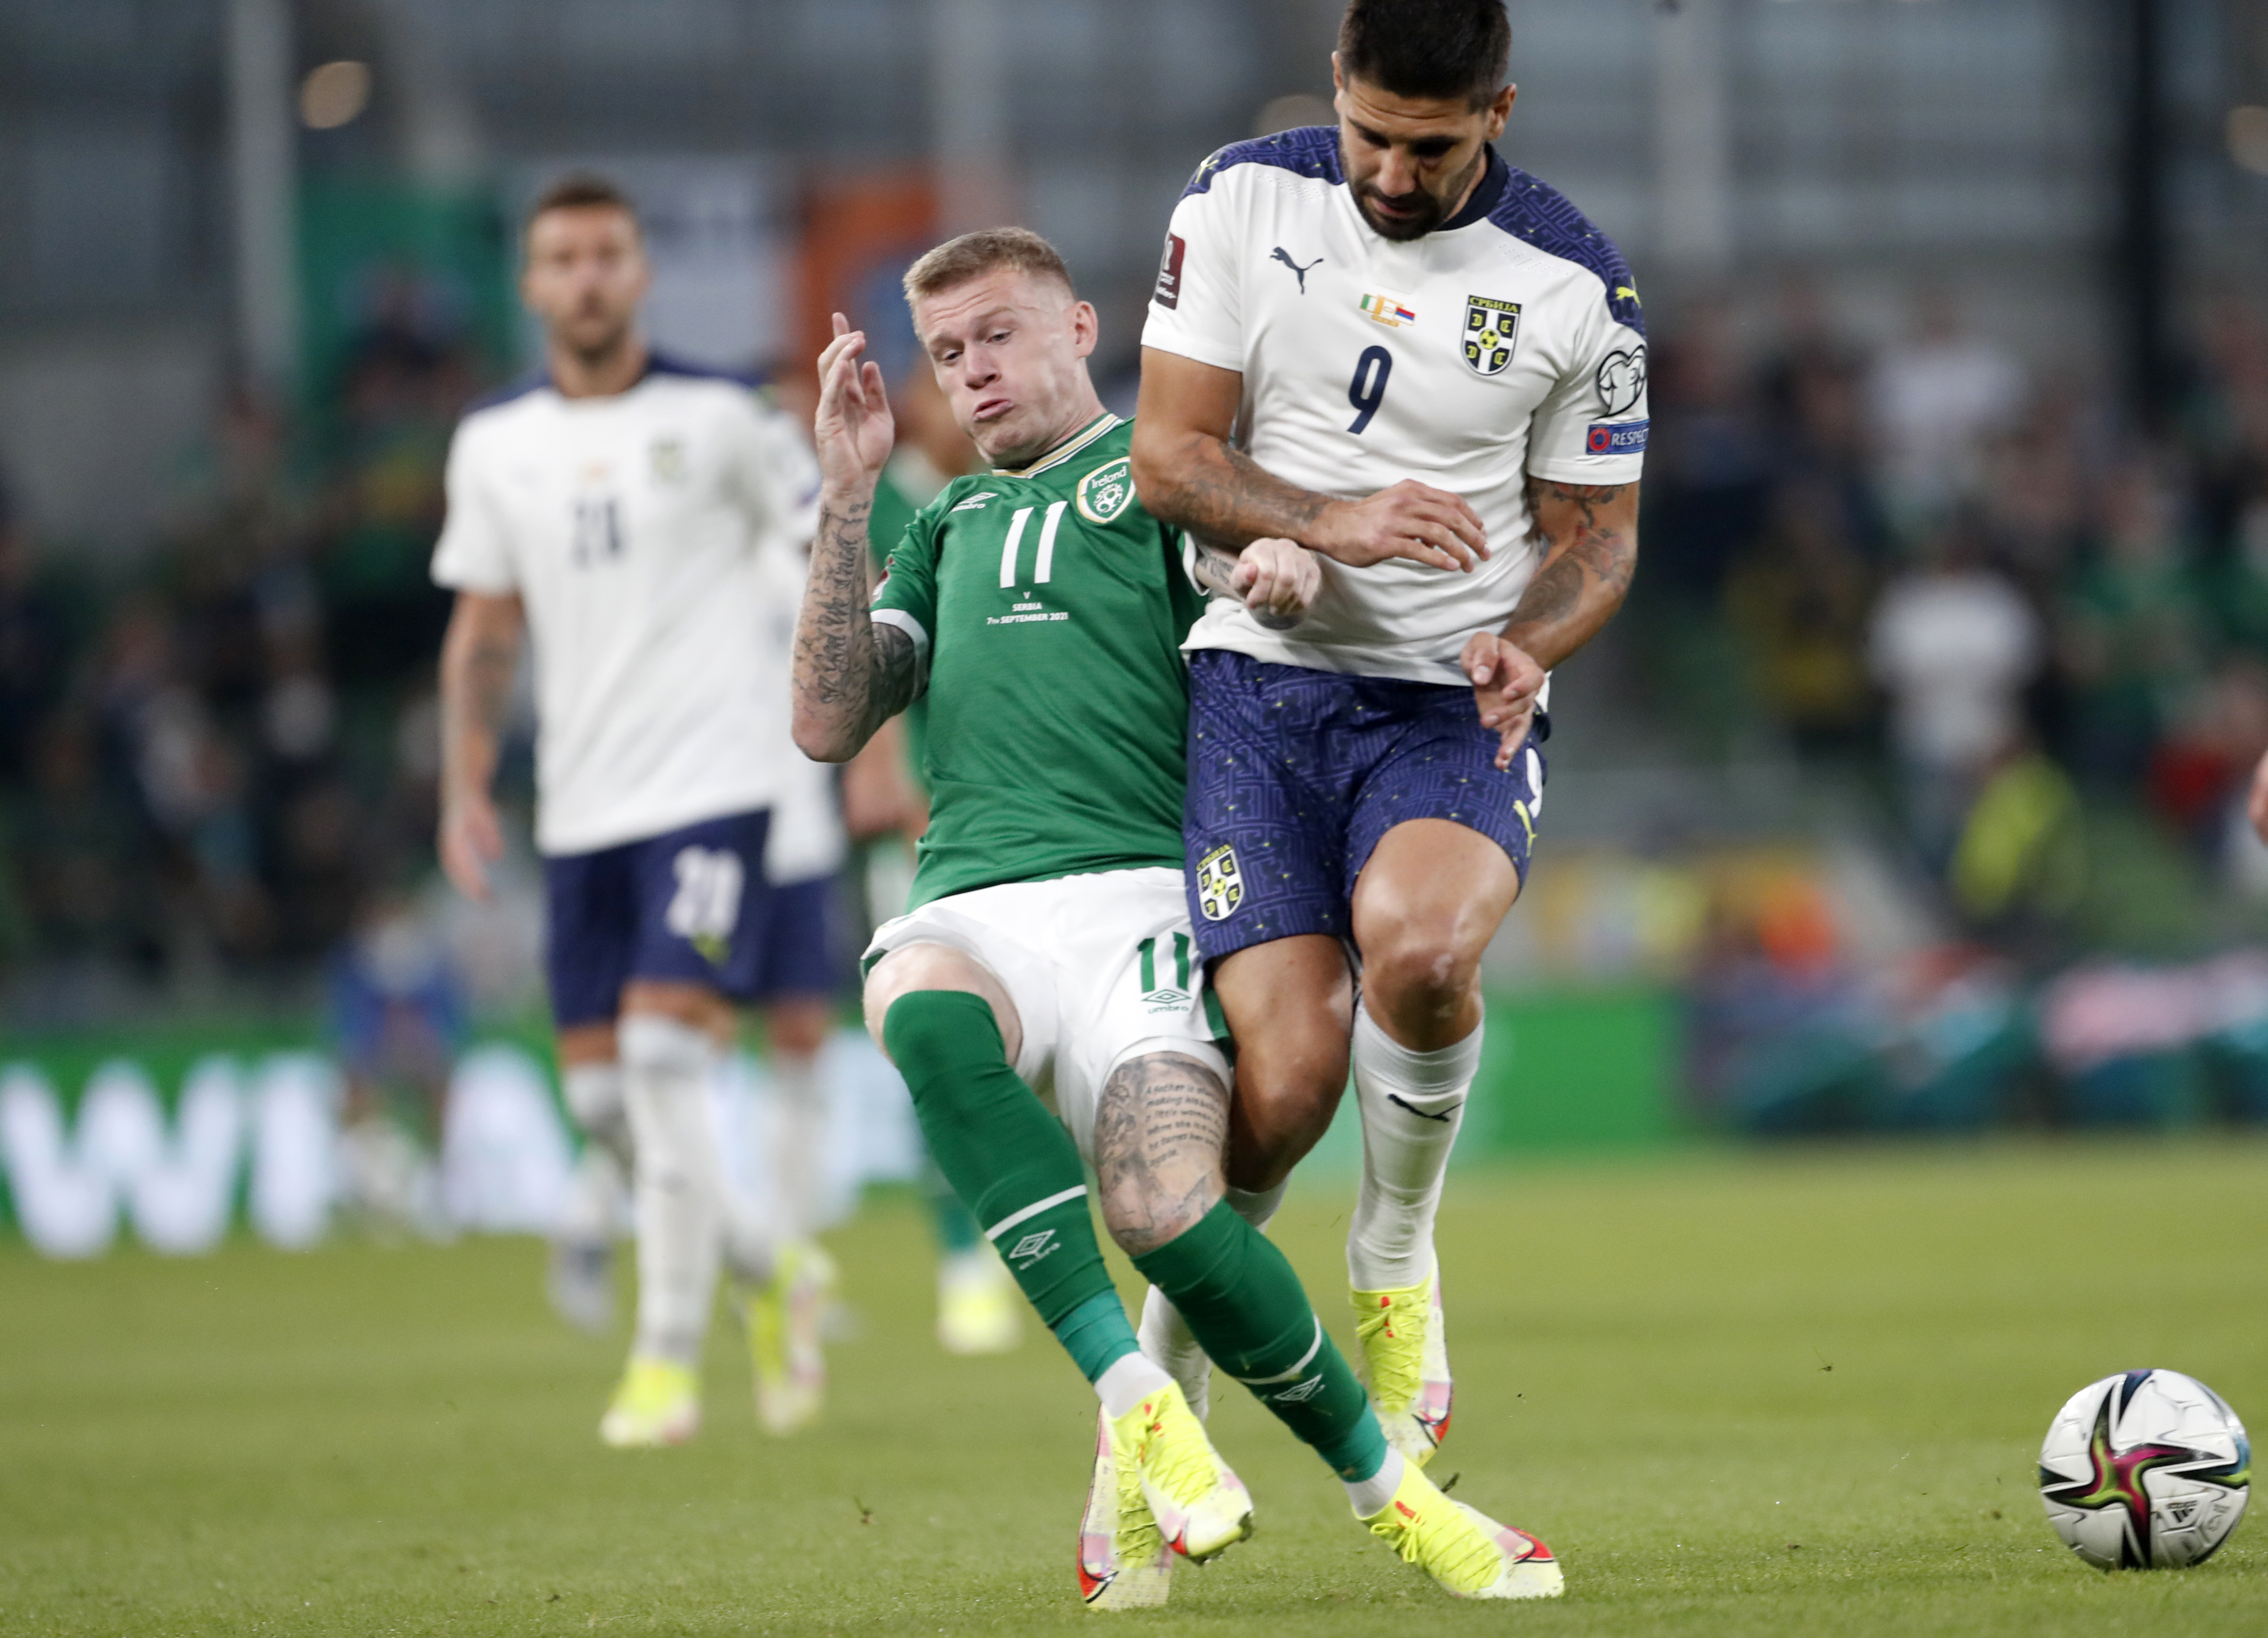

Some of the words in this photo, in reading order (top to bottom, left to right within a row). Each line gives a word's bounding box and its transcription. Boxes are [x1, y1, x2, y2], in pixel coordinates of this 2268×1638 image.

[1469, 296, 1518, 313] СРБИЈА
[1347, 345, 1392, 435] 9
[1092, 466, 1127, 489] Ireland
[1000, 501, 1068, 589] 11
[1012, 602, 1042, 612] SERBIA
[1000, 614, 1048, 624] SEPTEMBER
[1049, 612, 1069, 621] 2021
[1138, 932, 1190, 993] 11
[1148, 1004, 1189, 1014] umbro
